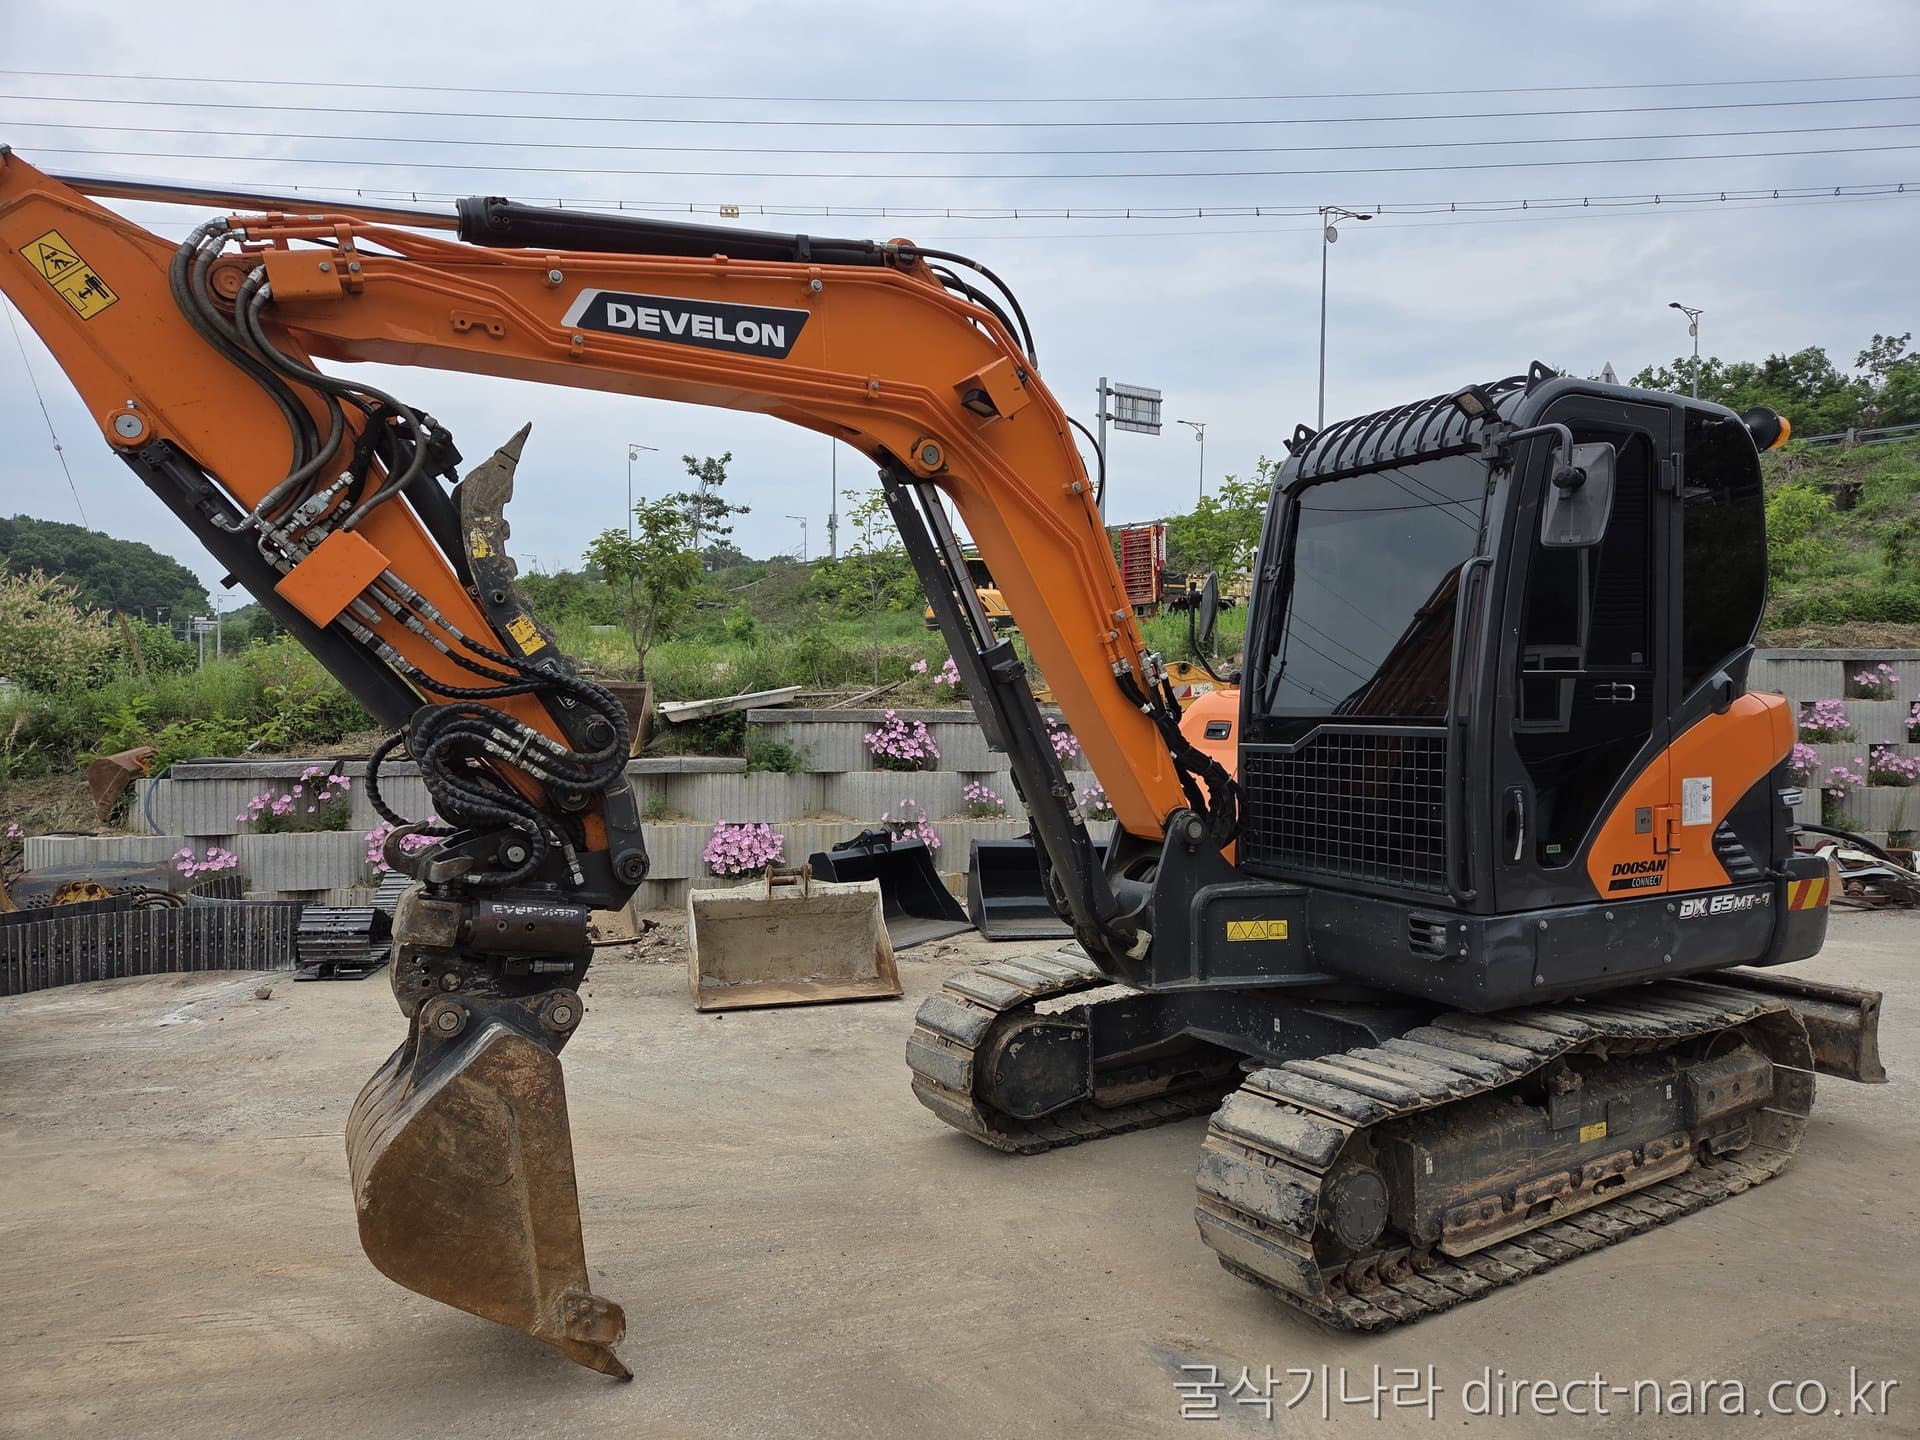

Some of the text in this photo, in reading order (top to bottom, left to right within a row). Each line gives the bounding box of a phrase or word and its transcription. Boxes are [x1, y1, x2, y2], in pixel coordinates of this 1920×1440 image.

[606, 302, 785, 348] DEVELON
[1612, 860, 1666, 875] DOOSAN
[1631, 875, 1661, 888] CONNECT
[1679, 897, 1708, 919] DX
